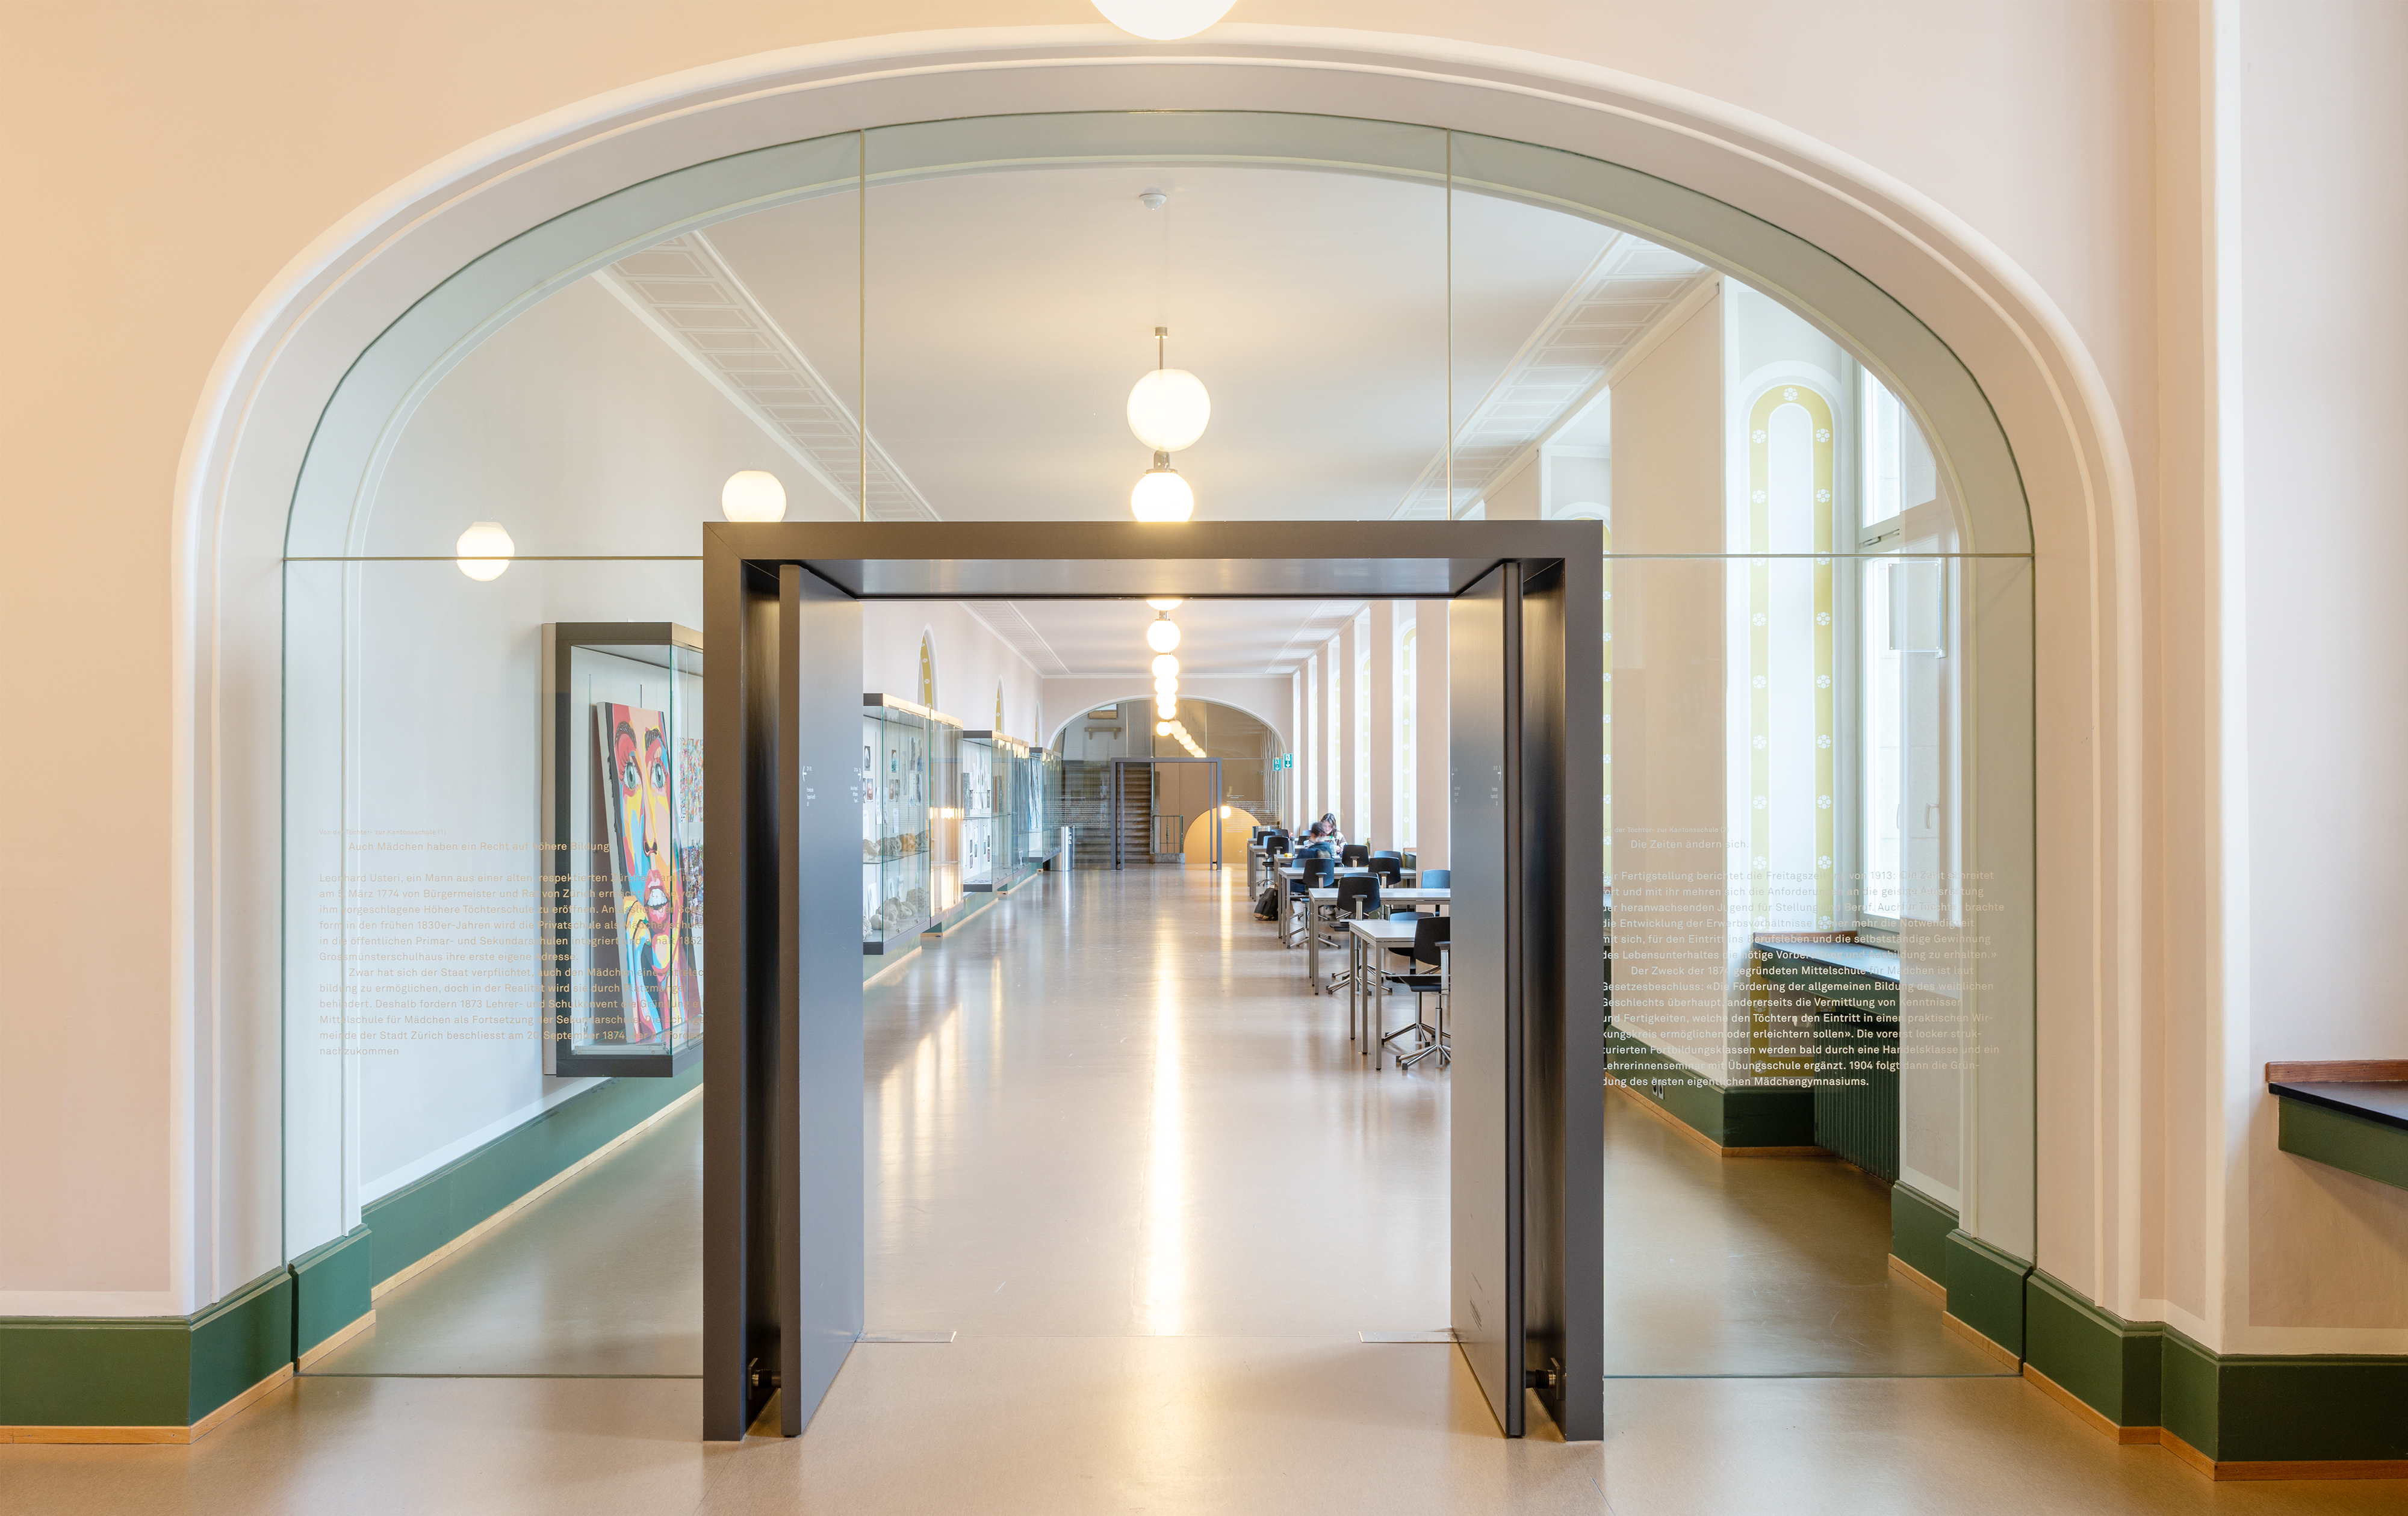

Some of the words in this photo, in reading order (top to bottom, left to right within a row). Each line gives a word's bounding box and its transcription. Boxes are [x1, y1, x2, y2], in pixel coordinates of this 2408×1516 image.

[349, 842, 374, 850] Auch
[377, 842, 423, 850] Mädchen
[427, 842, 458, 850] haben
[461, 842, 476, 850] ein
[480, 842, 509, 850] Recht
[512, 842, 529, 850] auf
[532, 842, 567, 850] höhere
[1631, 840, 1646, 849] Die
[1650, 840, 1682, 849] Zeiten
[1686, 840, 1722, 849] ändern
[370, 874, 404, 883] Usteri,
[406, 874, 421, 882] ein
[426, 874, 453, 882] Mann
[478, 874, 503, 882] einer
[507, 874, 536, 883] alten,
[539, 874, 607, 884] respektierten
[1622, 872, 1693, 882] Fertigstellung
[349, 889, 373, 898] März
[377, 889, 399, 898] 1774
[424, 889, 496, 900] Bürgermeister
[500, 889, 518, 898] und
[522, 889, 539, 898] Rat
[563, 889, 595, 898] Zürich
[320, 905, 338, 914] ihm
[424, 905, 460, 914] Höhere
[463, 905, 534, 914] Töchterschule
[553, 905, 599, 914] eröffnen.
[1621, 903, 1714, 912] heranwachsenden
[1845, 903, 1875, 912] Beruf.
[1620, 919, 1683, 930] Entwicklung
[1686, 919, 1703, 927] der
[1852, 919, 1878, 927] mehr
[320, 936, 328, 945] in
[350, 936, 412, 945] öffentlichen
[416, 936, 454, 945] Primar-
[458, 936, 476, 945] und
[480, 936, 568, 945] Sekundarschulen
[572, 936, 619, 947] integriert
[1621, 935, 1645, 944] sich,
[1648, 935, 1663, 943] für
[1666, 935, 1684, 943] den
[1689, 935, 1725, 943] Eintritt
[1813, 935, 1832, 943] und
[1835, 935, 1851, 943] die
[1854, 935, 1931, 945] selbstständige
[498, 953, 532, 963] eigene
[1623, 951, 1719, 959] Lebensunterhaltes
[1742, 951, 1773, 961] nötige
[349, 968, 374, 977] Zwar
[377, 968, 394, 977] hat
[397, 968, 418, 977] sich
[421, 968, 438, 977] der
[441, 968, 468, 977] Staat
[472, 968, 534, 979] verpflichtet,
[538, 968, 562, 977] auch
[565, 968, 583, 977] den
[1631, 967, 1649, 975] Der
[1651, 967, 1684, 975] Zweck
[1688, 967, 1705, 975] der
[1734, 967, 1798, 977] gegründeten
[1802, 967, 1866, 975] Mittelschule
[375, 984, 441, 994] ermöglichen,
[444, 984, 468, 992] doch
[473, 984, 481, 992] in
[485, 984, 501, 992] der
[504, 984, 545, 992] Realität
[548, 984, 570, 992] wird
[573, 984, 588, 992] sie
[591, 984, 620, 992] durch
[1733, 982, 1786, 993] Förderung
[1789, 982, 1805, 991] der
[1808, 982, 1871, 993] allgemeinen
[1875, 982, 1914, 993] Bildung
[376, 1000, 416, 1008] Deshalb
[420, 1000, 457, 1008] fordern
[460, 1000, 482, 1008] 1873
[486, 1000, 523, 1008] Lehrer-
[527, 1000, 545, 1008] und
[548, 1000, 618, 1008] Schulkonvent
[1727, 998, 1792, 1006] andererseits
[1796, 998, 1811, 1006] die
[1814, 998, 1875, 1009] Vermittlung
[386, 1015, 402, 1024] für
[405, 1015, 450, 1024] Mädchen
[454, 1015, 469, 1024] als
[473, 1015, 533, 1026] Fortsetzung
[536, 1015, 553, 1024] der
[1624, 1014, 1689, 1024] Fertigkeiten,
[1692, 1014, 1728, 1023] welche
[1731, 1014, 1750, 1023] den
[1753, 1014, 1798, 1023] Töchtern
[1801, 1014, 1820, 1023] den
[1823, 1014, 1861, 1023] Eintritt
[1864, 1014, 1873, 1023] in
[360, 1031, 377, 1039] der
[380, 1031, 407, 1039] Stadt
[411, 1031, 443, 1039] Zürich
[447, 1031, 505, 1039] beschliesst
[544, 1031, 600, 1042] September
[1660, 1030, 1724, 1040] ermöglichen
[1727, 1030, 1750, 1038] oder
[1753, 1030, 1810, 1038] erleichtern
[1813, 1030, 1854, 1038] sollen».
[1857, 1030, 1873, 1038] Die
[1758, 1045, 1796, 1054] werden
[1799, 1045, 1822, 1054] bald
[1825, 1045, 1854, 1054] durch
[1858, 1045, 1879, 1054] eine
[1728, 1060, 1801, 1072] Übungsschule
[1804, 1062, 1846, 1072] ergänzt.
[1876, 1062, 1900, 1072] folgt
[1630, 1077, 1648, 1086] des
[1651, 1077, 1684, 1086] ersten
[1687, 1077, 1751, 1087] eigentlichen
[1754, 1077, 1869, 1087] Mädchengymnasiums.
